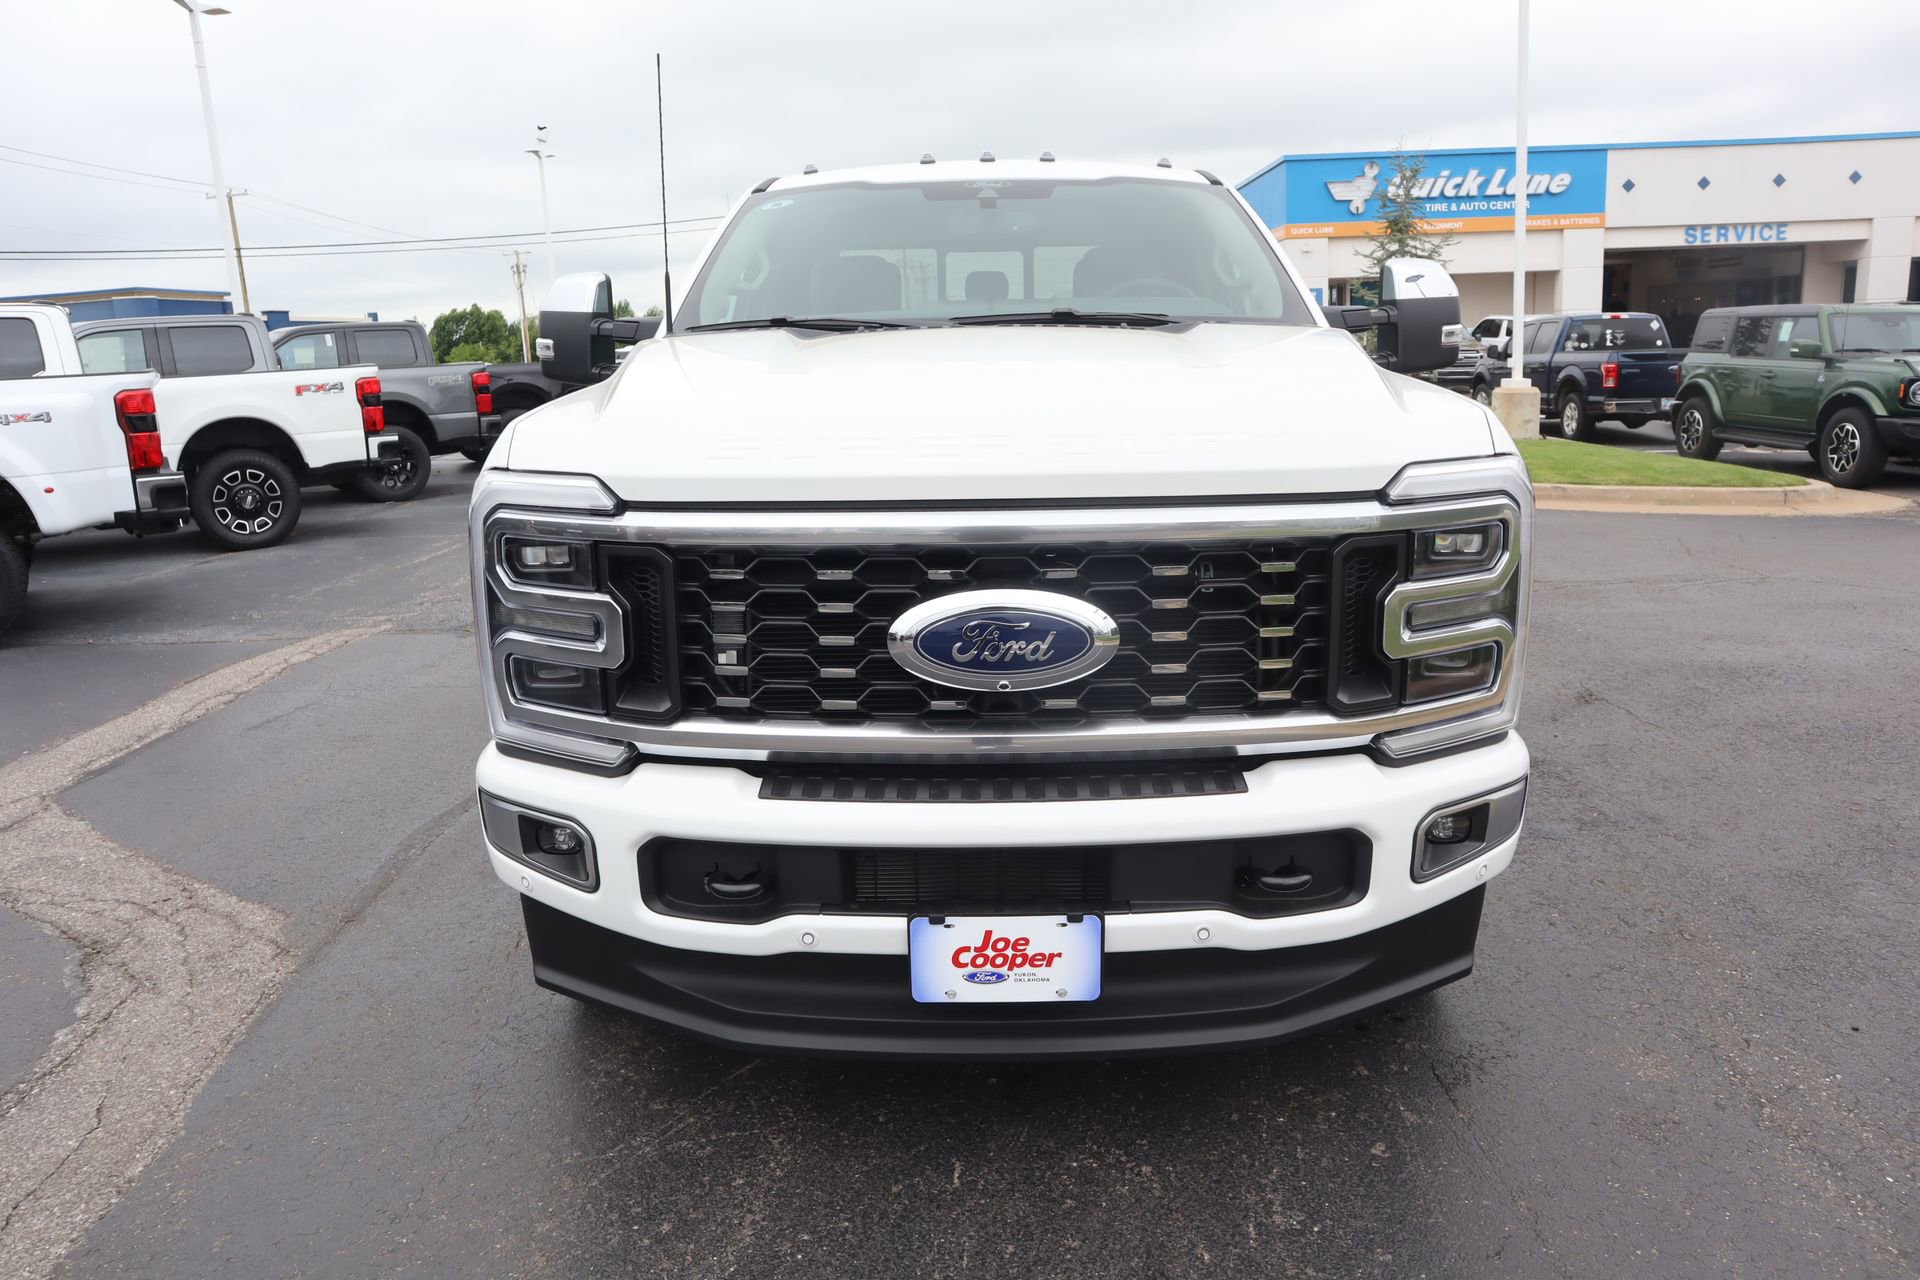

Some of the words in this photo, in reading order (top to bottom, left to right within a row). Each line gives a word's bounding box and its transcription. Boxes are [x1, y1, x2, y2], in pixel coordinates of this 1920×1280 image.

[1425, 203, 1448, 212] TIRE
[1450, 202, 1458, 211] &
[1459, 201, 1488, 211] AUTO
[1489, 200, 1530, 210] CENTR
[1560, 217, 1600, 226] BATTERIES
[1291, 226, 1313, 235] QUICK
[1314, 226, 1334, 234] LUBE
[1684, 223, 1788, 244] SERVICE
[295, 382, 344, 396] FX4
[951, 619, 1057, 663] Ford
[973, 929, 1030, 953] Joe
[951, 945, 1063, 972] Cooper
[974, 971, 998, 982] Ford
